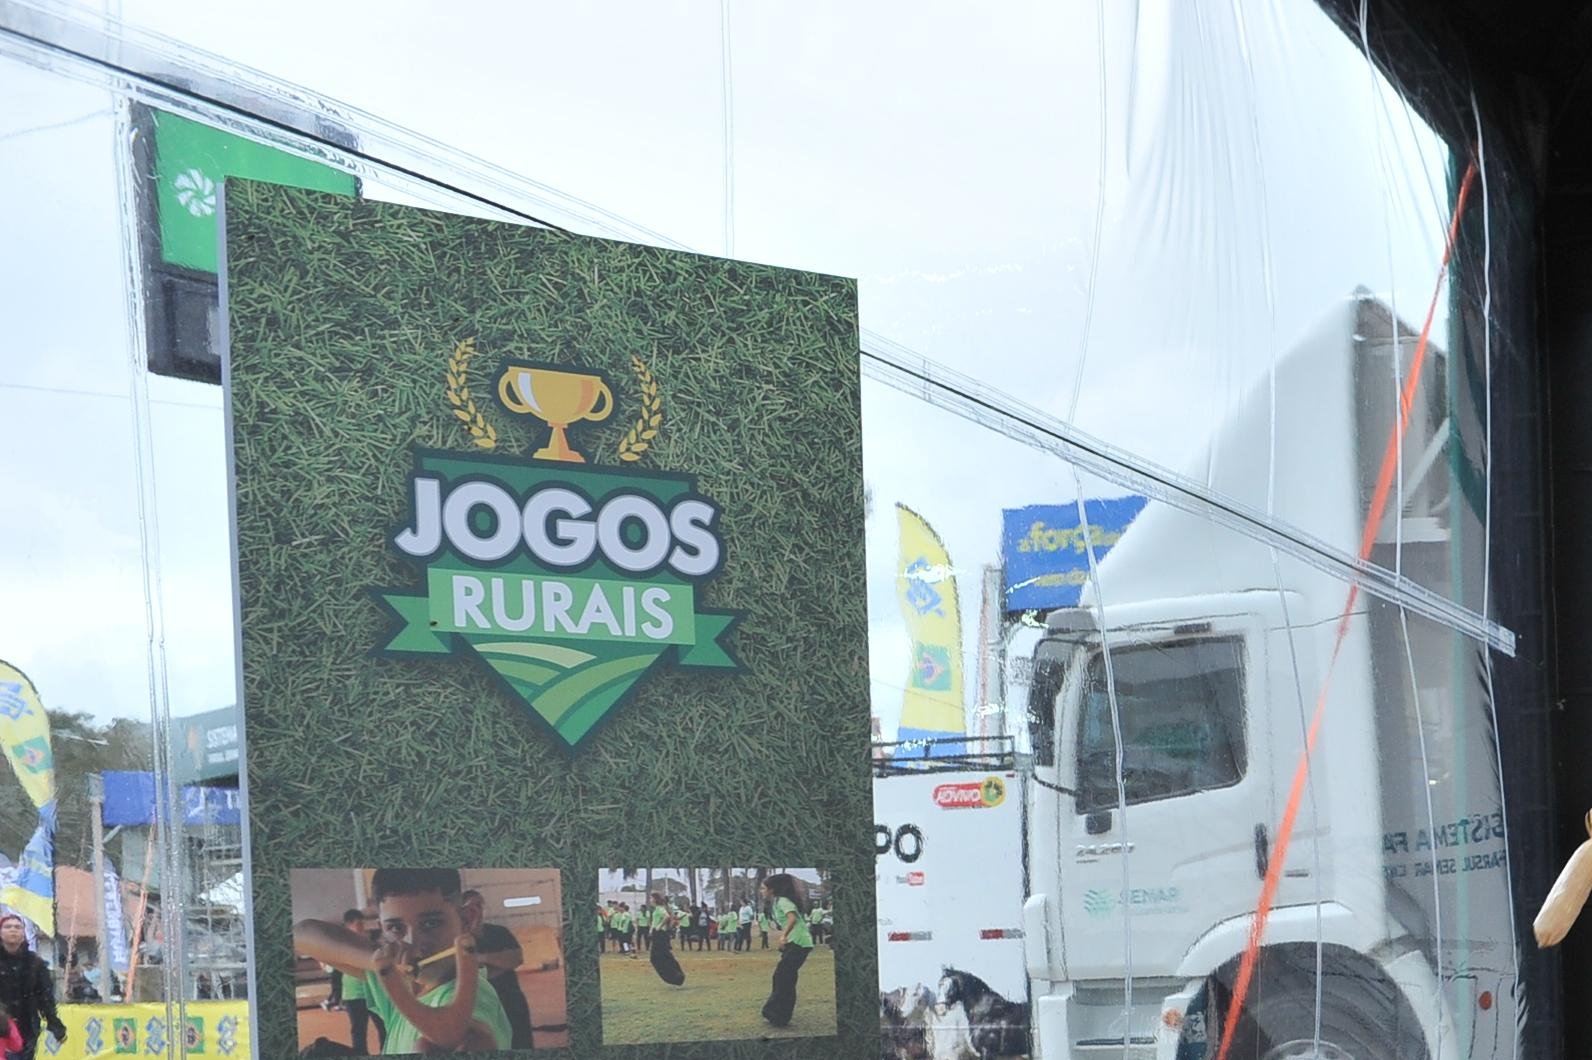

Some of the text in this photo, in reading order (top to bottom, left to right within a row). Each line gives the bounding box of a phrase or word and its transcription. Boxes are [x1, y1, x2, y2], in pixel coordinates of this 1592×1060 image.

[394, 477, 720, 576] JOGOS
[452, 575, 674, 640] RURAIS
[873, 823, 924, 864] PO
